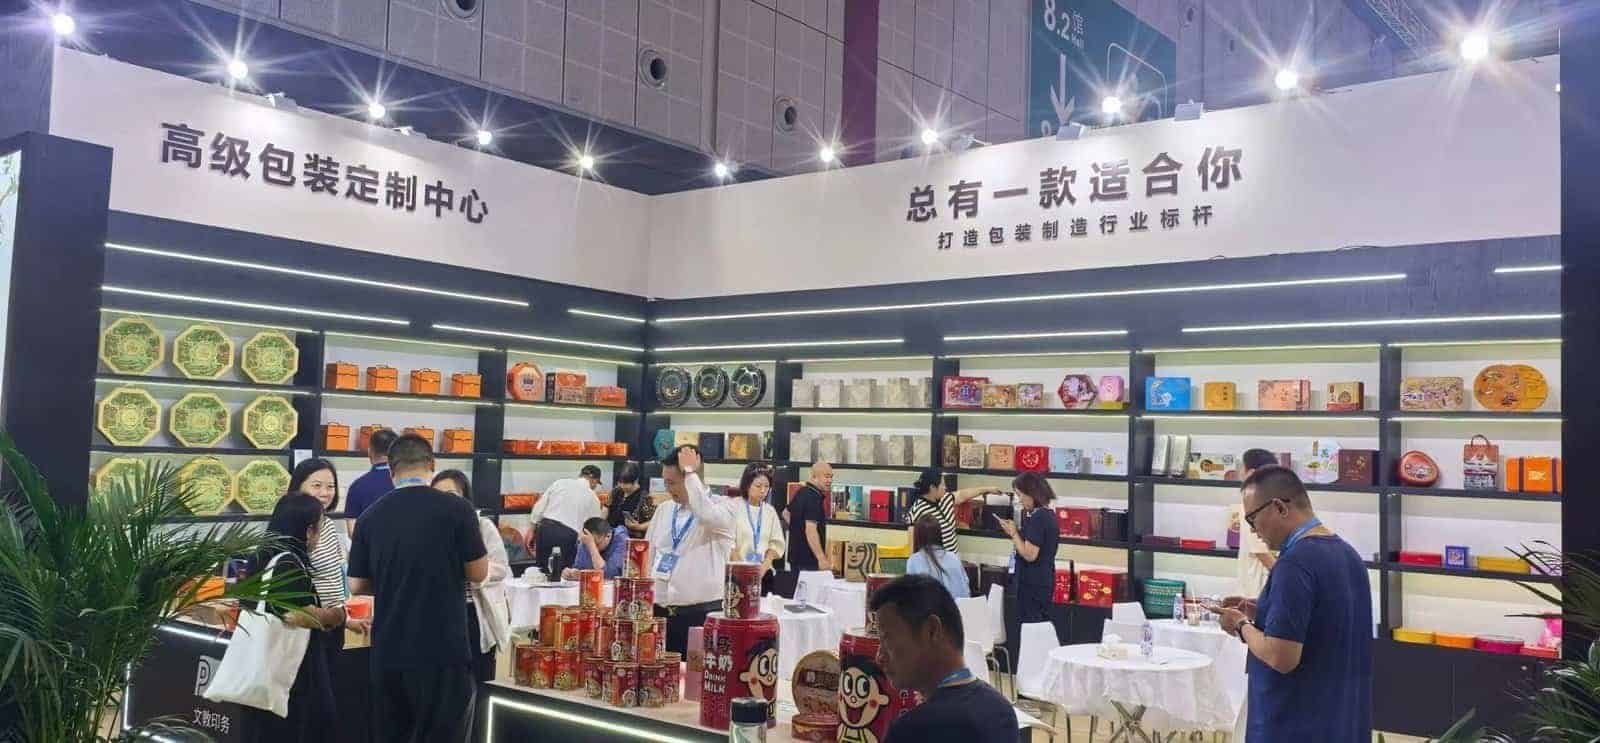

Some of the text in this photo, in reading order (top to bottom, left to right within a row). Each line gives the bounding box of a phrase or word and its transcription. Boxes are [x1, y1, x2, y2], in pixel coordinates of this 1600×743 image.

[160, 121, 490, 224] 高级包装定制中心
[906, 145, 1244, 223] 总有一款适合你
[937, 204, 1215, 250] 打造包装制造行业标杆
[703, 680, 726, 694] MILK
